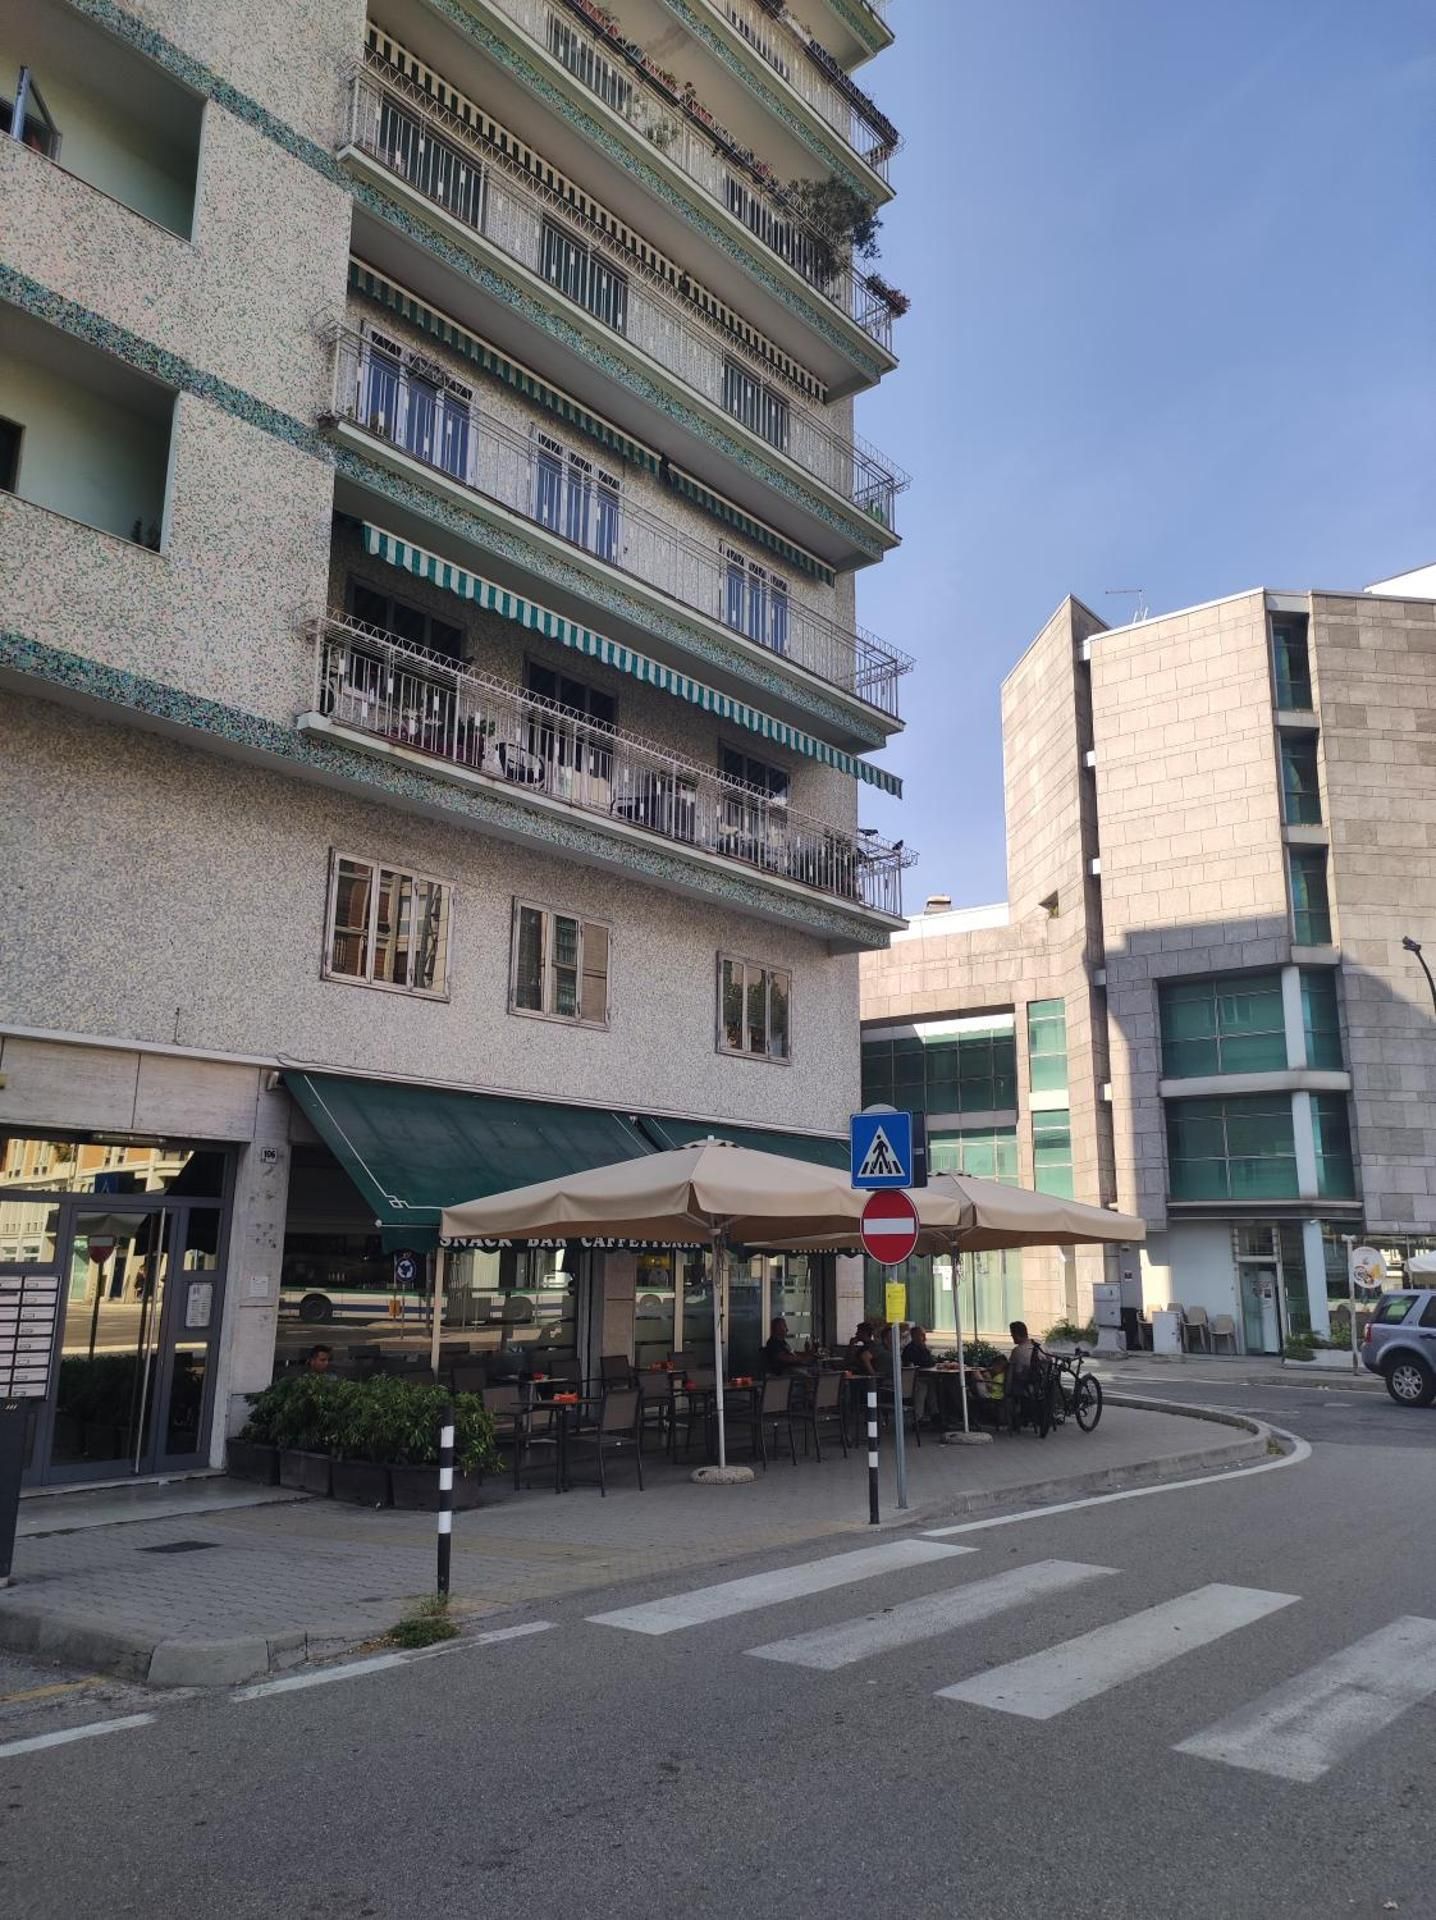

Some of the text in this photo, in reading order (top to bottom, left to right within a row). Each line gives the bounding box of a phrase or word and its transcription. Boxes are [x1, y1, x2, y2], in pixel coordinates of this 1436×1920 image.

[264, 1150, 276, 1159] 106
[439, 1237, 512, 1248] SNACK
[527, 1238, 568, 1248] BAR
